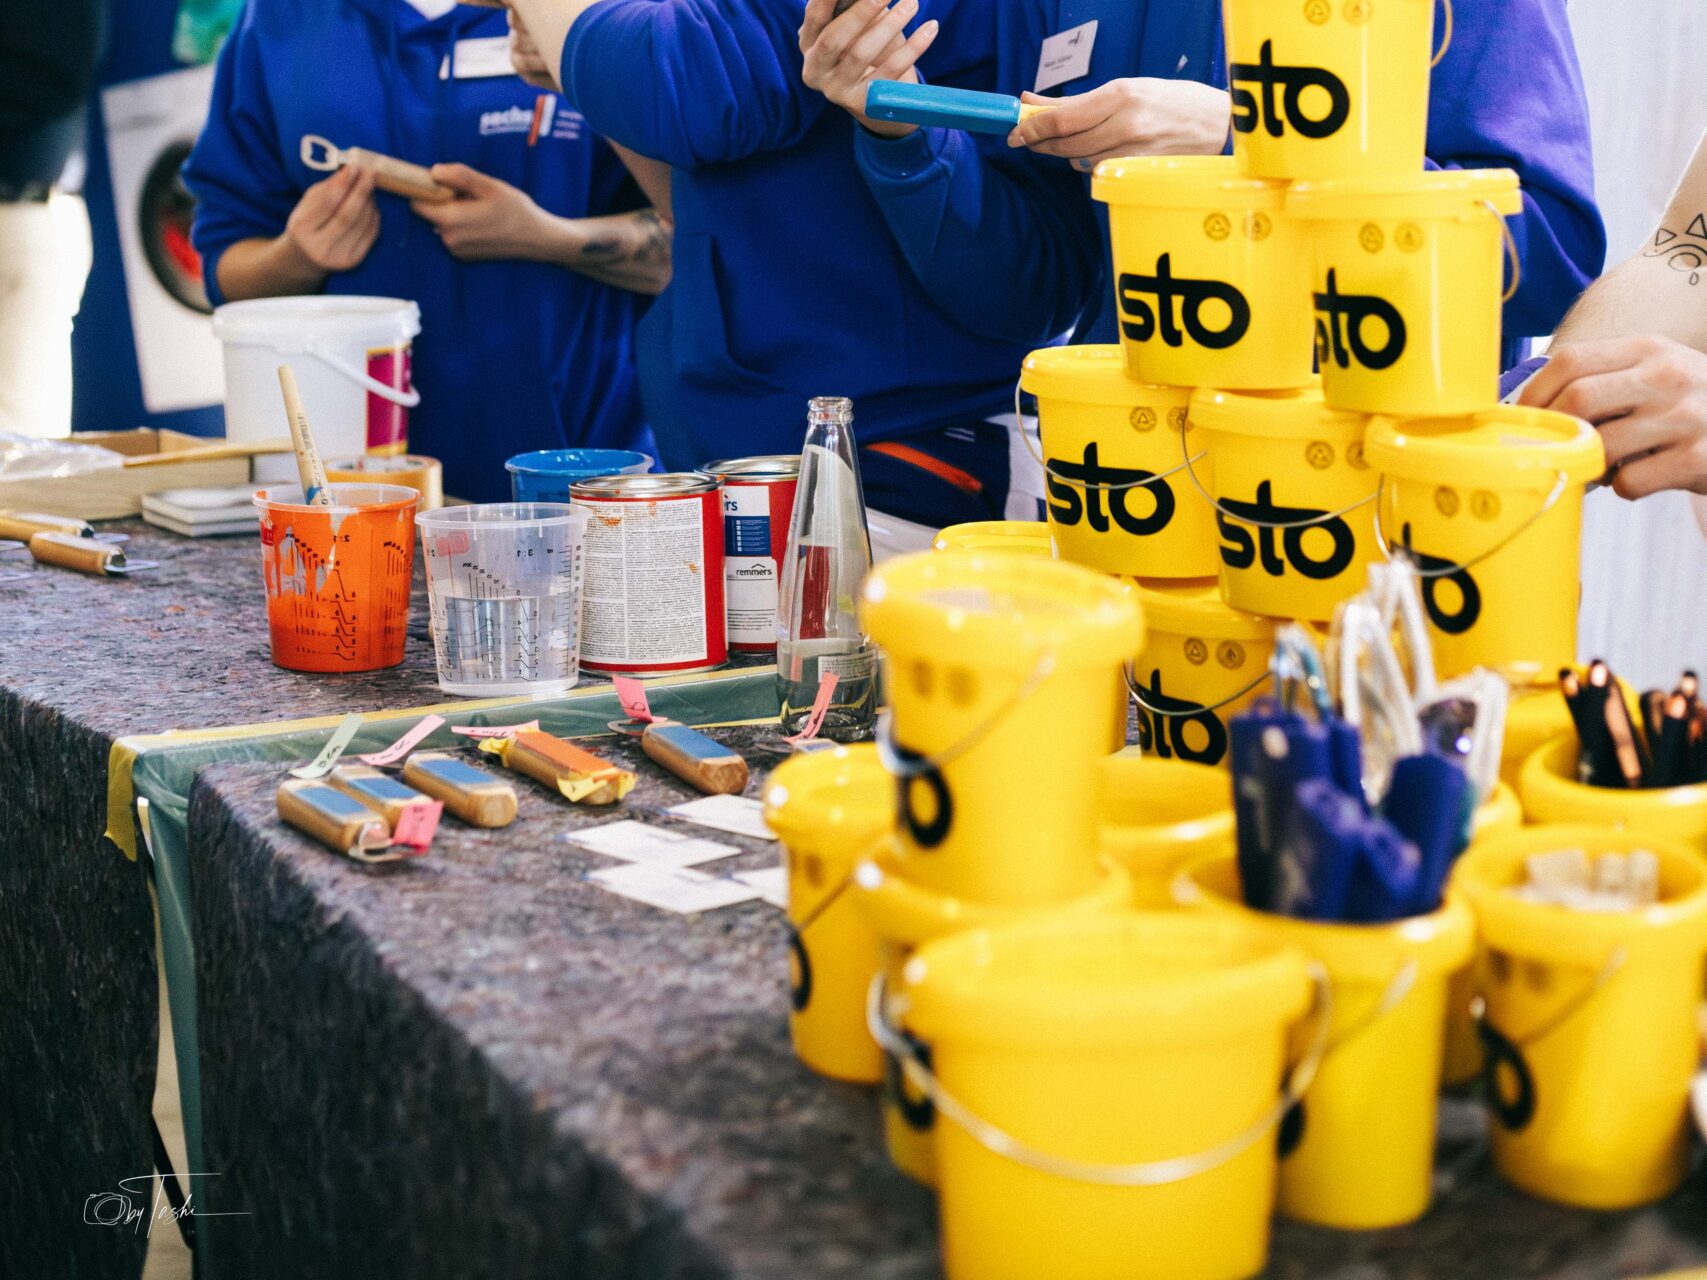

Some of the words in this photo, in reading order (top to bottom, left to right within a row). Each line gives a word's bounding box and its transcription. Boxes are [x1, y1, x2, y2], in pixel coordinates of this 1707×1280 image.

[1230, 39, 1350, 138] sto
[1119, 252, 1250, 349] sto
[1047, 441, 1175, 536] sto
[1216, 480, 1354, 579] sto
[736, 568, 773, 576] remmers
